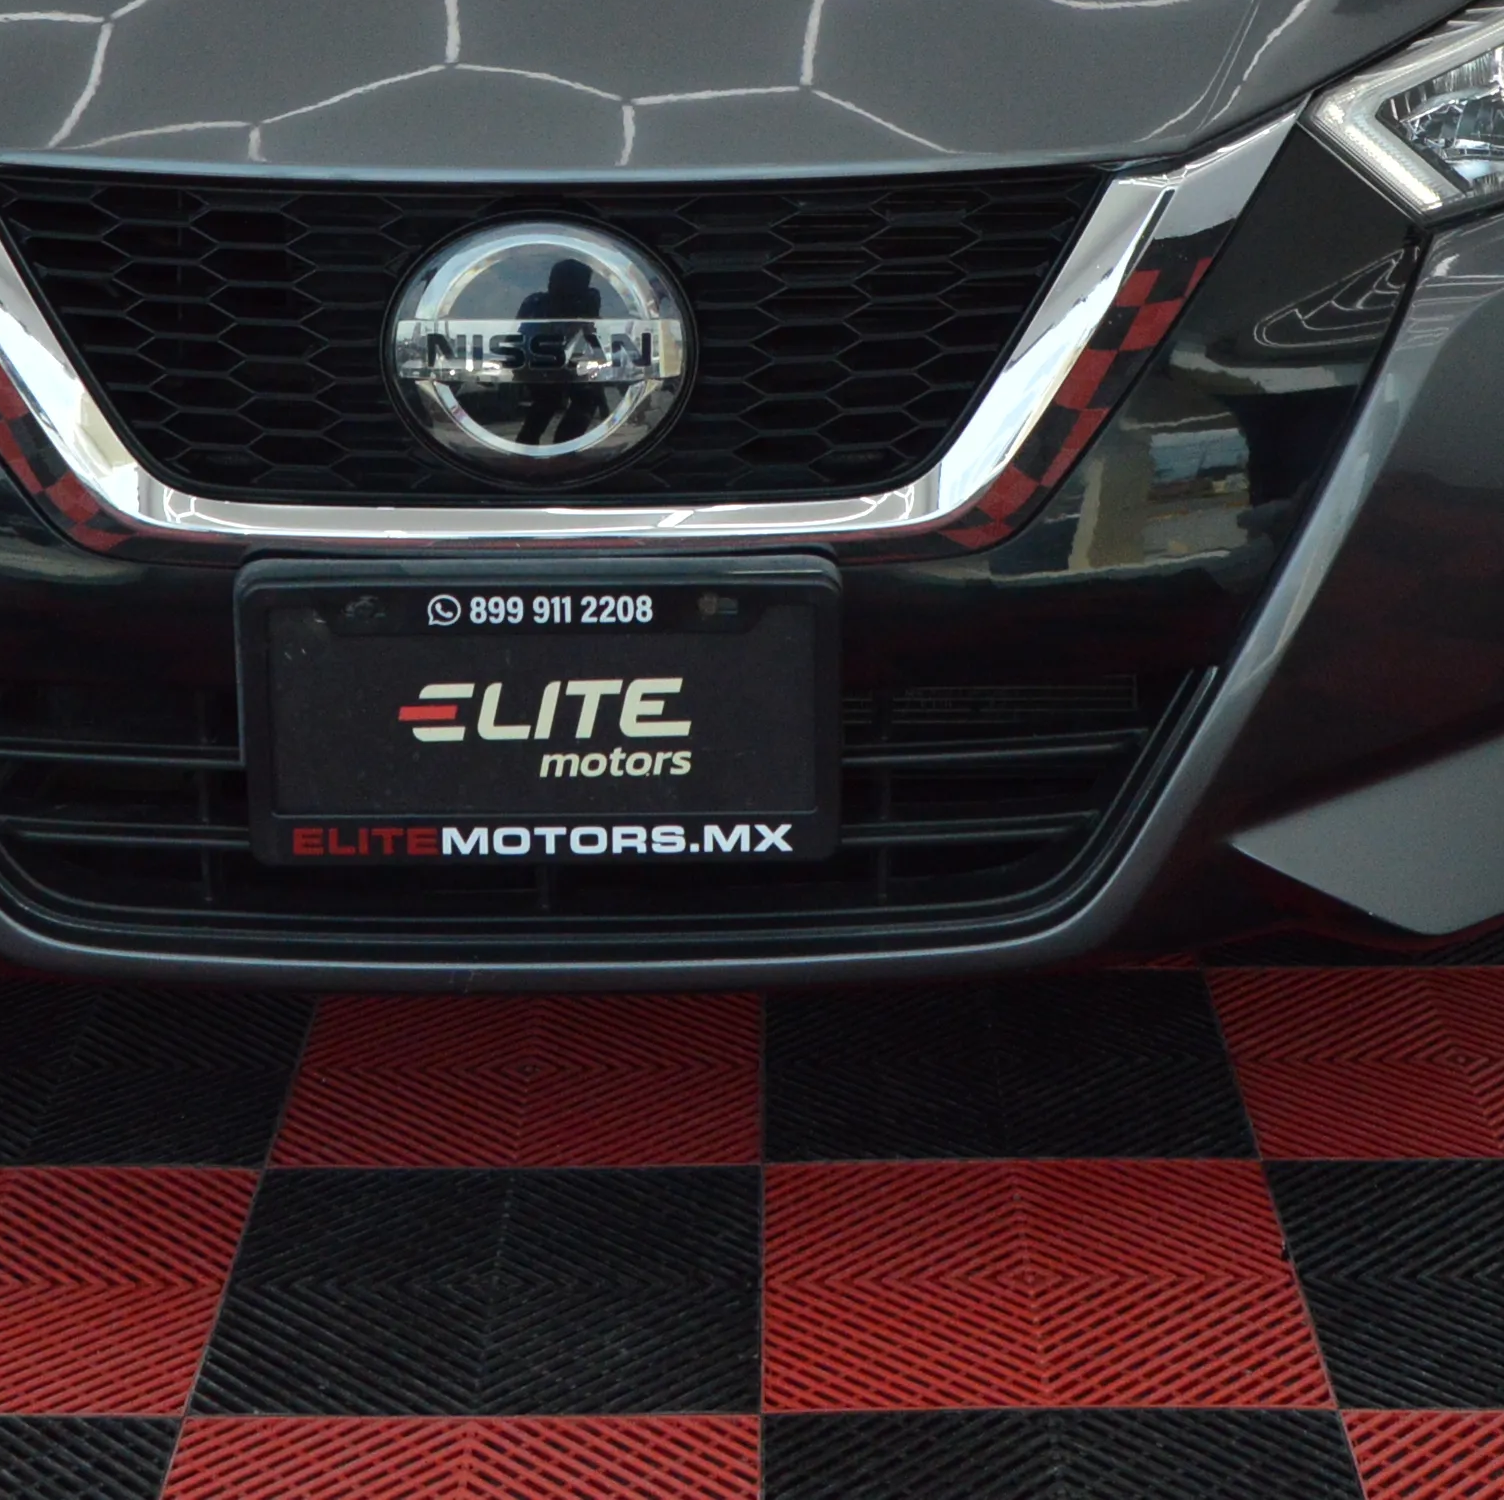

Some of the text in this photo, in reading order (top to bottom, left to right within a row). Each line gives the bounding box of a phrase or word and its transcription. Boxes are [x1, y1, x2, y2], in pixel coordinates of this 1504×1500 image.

[426, 332, 652, 370] NISSAN
[469, 596, 654, 624] 899 911 2208
[399, 677, 692, 742] ELITE
[539, 746, 692, 778] motors
[292, 823, 793, 856] ELITEMOTORS.MX
